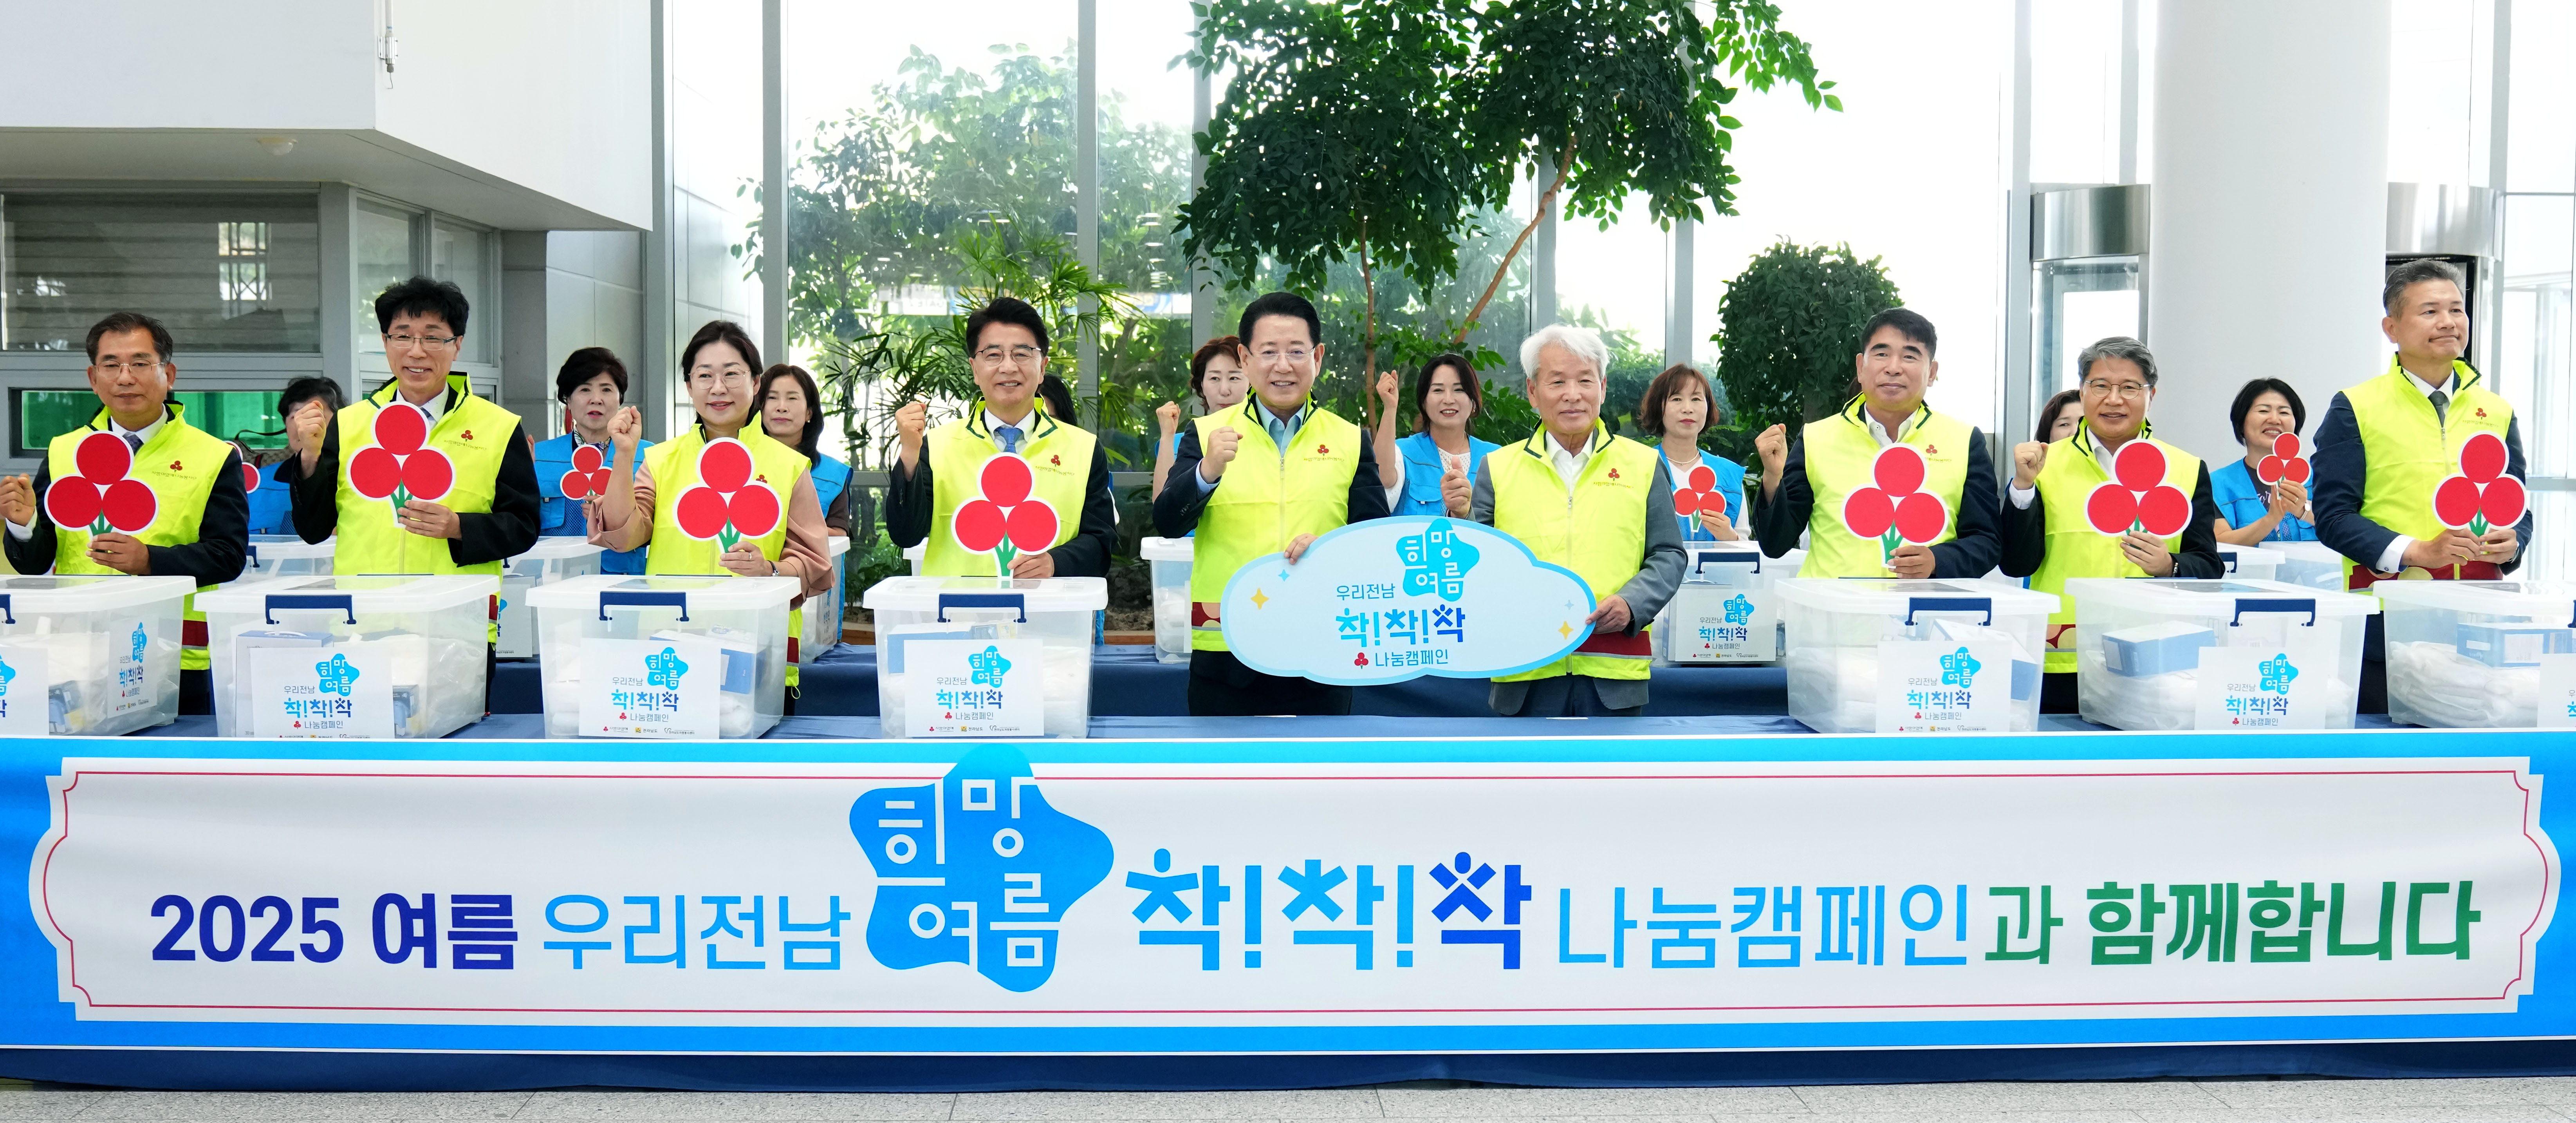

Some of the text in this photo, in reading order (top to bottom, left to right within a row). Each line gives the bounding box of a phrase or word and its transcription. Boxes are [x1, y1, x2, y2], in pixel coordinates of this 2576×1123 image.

[1404, 530, 1455, 570] 희망
[1415, 562, 1464, 596] 여름
[1336, 583, 1395, 601] 우리전남
[1727, 598, 1746, 613] 희망
[1729, 610, 1747, 623] 여름
[650, 653, 676, 673] 희망
[973, 651, 998, 671] 희망
[1375, 649, 1448, 668] 나눔캠페인
[1944, 653, 1969, 672] 희망
[320, 659, 346, 680] 희망
[978, 668, 1003, 684] 여름
[1948, 669, 1972, 685] 여름
[2262, 659, 2287, 678] 희망
[325, 676, 351, 693] 여름
[612, 677, 643, 686] 우리전남
[654, 670, 680, 687] 여름
[2266, 675, 2289, 691] 여름
[284, 685, 316, 694] 우리전남
[2227, 684, 2256, 692] 우리전남
[304, 720, 343, 729] 나눔캠페인
[630, 713, 669, 722] 나눔캠페인
[955, 712, 994, 720] 나눔캠페인
[1925, 712, 1962, 720] 나눔캠페인
[877, 777, 1036, 886] 희망
[151, 894, 344, 964] 2025
[372, 893, 518, 970] 여름
[543, 894, 852, 970] 우리전남
[2089, 880, 2481, 965] 함께합니다
[908, 873, 1060, 971] 여름
